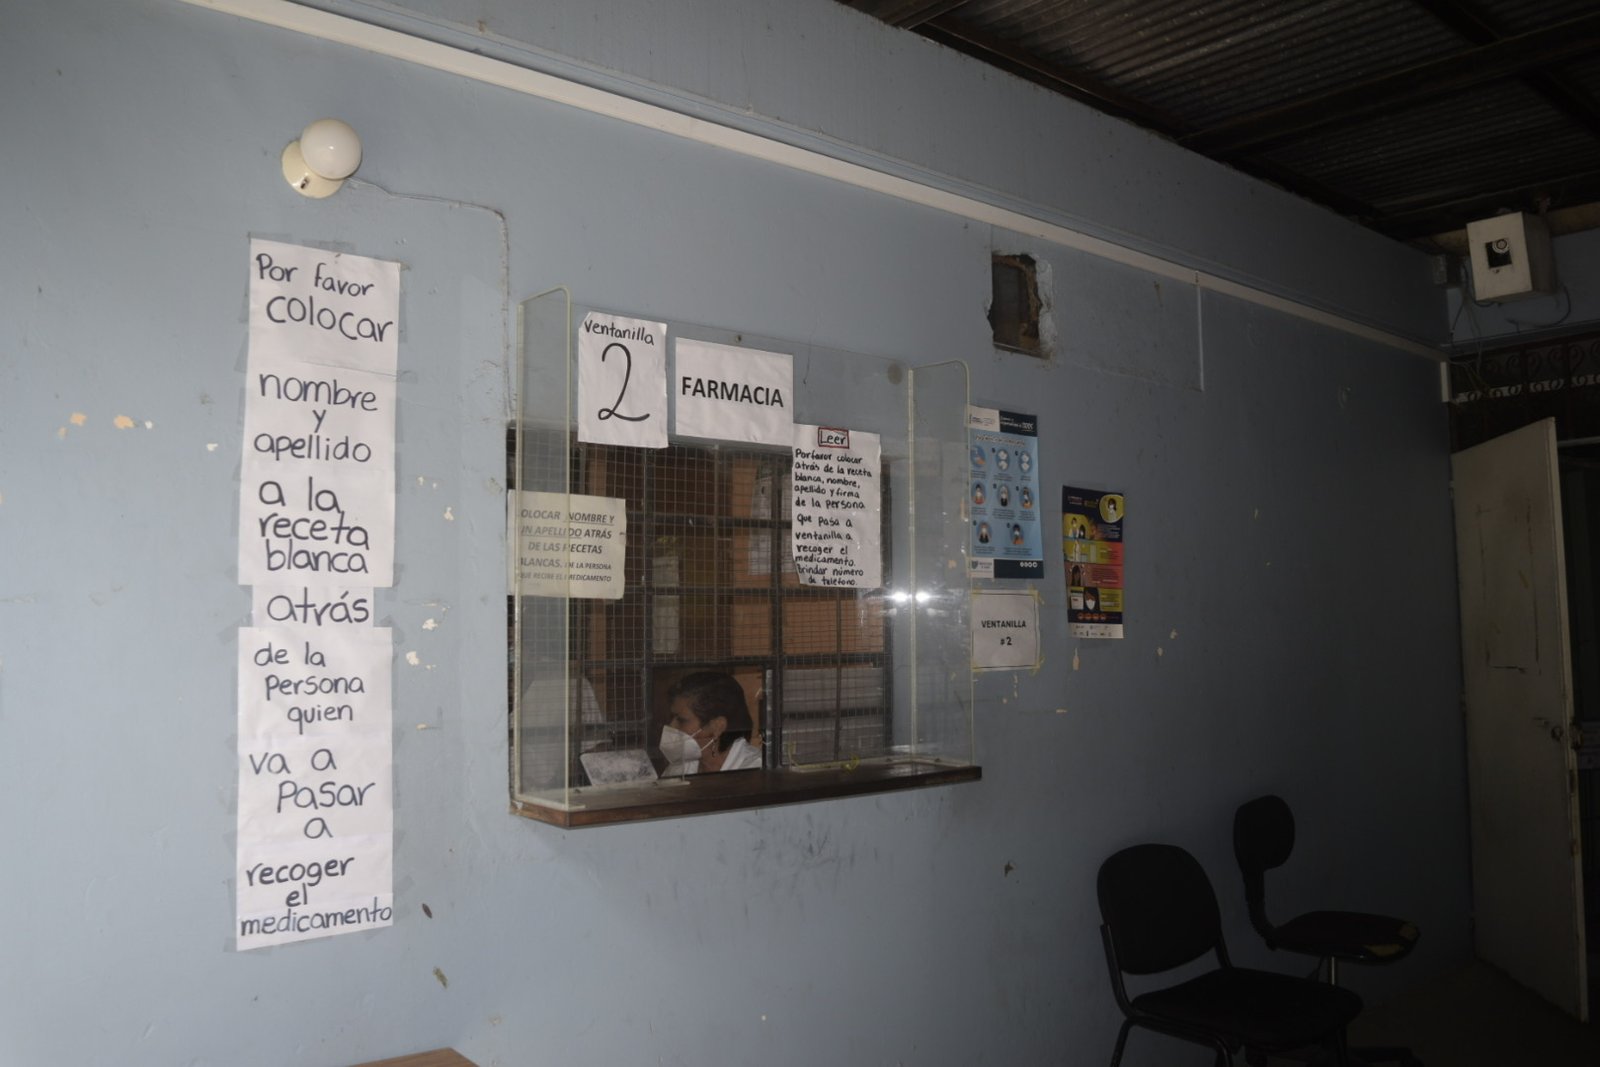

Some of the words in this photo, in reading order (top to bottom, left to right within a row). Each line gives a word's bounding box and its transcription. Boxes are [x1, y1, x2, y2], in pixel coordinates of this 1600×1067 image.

[255, 253, 298, 281] Por
[313, 262, 375, 298] favor
[259, 373, 378, 412] nombre
[598, 342, 650, 421] 2
[681, 376, 784, 408] FARMACIA
[312, 409, 327, 433] y
[254, 433, 372, 462] apellido
[820, 430, 846, 445] Leer
[823, 464, 834, 473] de
[837, 465, 845, 475] la
[846, 467, 872, 478] receta
[837, 453, 864, 465] colocar
[258, 480, 286, 507] a
[307, 476, 342, 514] la
[794, 485, 826, 494] apellido
[830, 489, 835, 497] y
[836, 488, 861, 499] firma
[826, 477, 861, 489] nombre,
[795, 496, 806, 507] de
[811, 497, 821, 508] la
[520, 509, 561, 520] OLOCAR
[609, 515, 615, 524] Y
[845, 519, 853, 528] a
[258, 510, 370, 551] receta
[584, 527, 613, 540] ATRÁS
[795, 530, 843, 541] ventanilla
[845, 532, 854, 541] a
[265, 538, 369, 574] blanca
[528, 541, 541, 552] DE
[543, 542, 561, 553] LAS
[796, 544, 834, 556] recoger
[839, 545, 848, 556] el
[980, 619, 1027, 629] VENTANILLA
[253, 642, 290, 667] de
[304, 641, 327, 668] la
[286, 703, 353, 735] quien
[249, 751, 292, 775] va
[310, 748, 338, 771] a
[303, 817, 334, 840] a
[245, 856, 356, 887] recoger
[285, 883, 308, 908] el
[241, 896, 393, 937] medicamento
